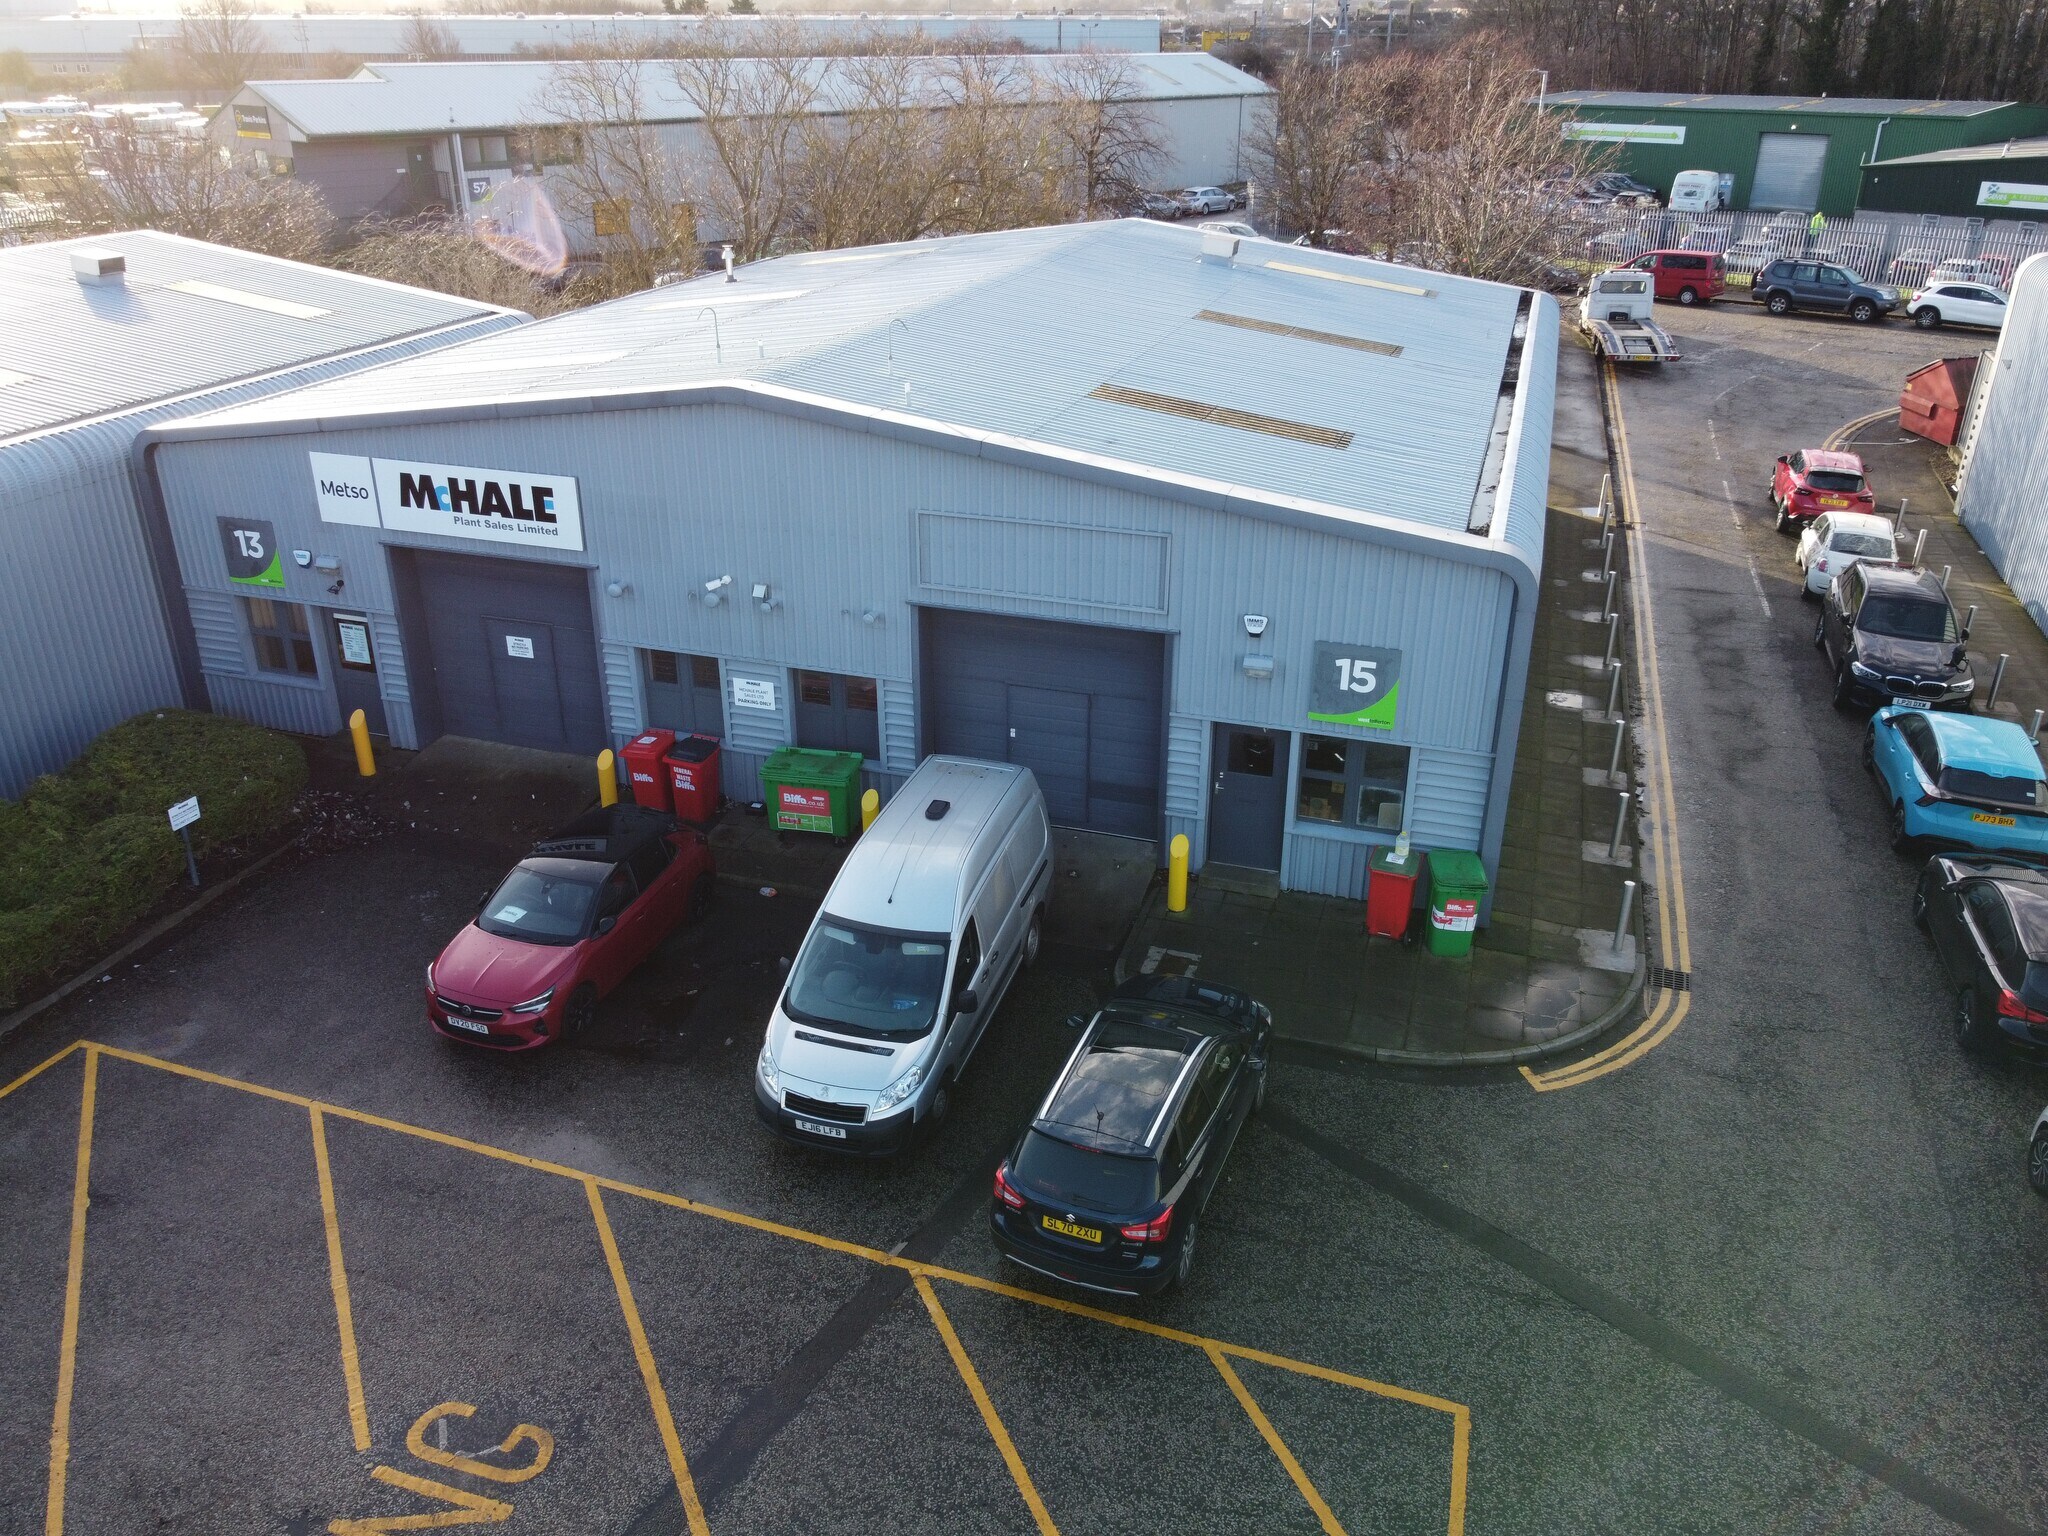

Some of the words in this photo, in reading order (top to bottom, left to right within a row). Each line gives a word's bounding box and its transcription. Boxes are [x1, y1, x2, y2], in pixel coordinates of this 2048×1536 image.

[473, 182, 486, 194] 57
[321, 479, 369, 500] Metso
[400, 472, 557, 524] McHALE
[454, 516, 481, 528] Plant
[484, 520, 514, 532] Sales
[517, 523, 558, 536] Limited
[233, 529, 264, 558] 13
[1335, 658, 1377, 693] 15
[633, 773, 653, 782] Biffa
[674, 766, 693, 775] GENERAL
[675, 780, 695, 791] Biffa
[801, 1121, 821, 1133] EJ16
[823, 1126, 841, 1136] LFB
[1047, 1217, 1074, 1233] SL70
[1076, 1226, 1097, 1240] ZXU
